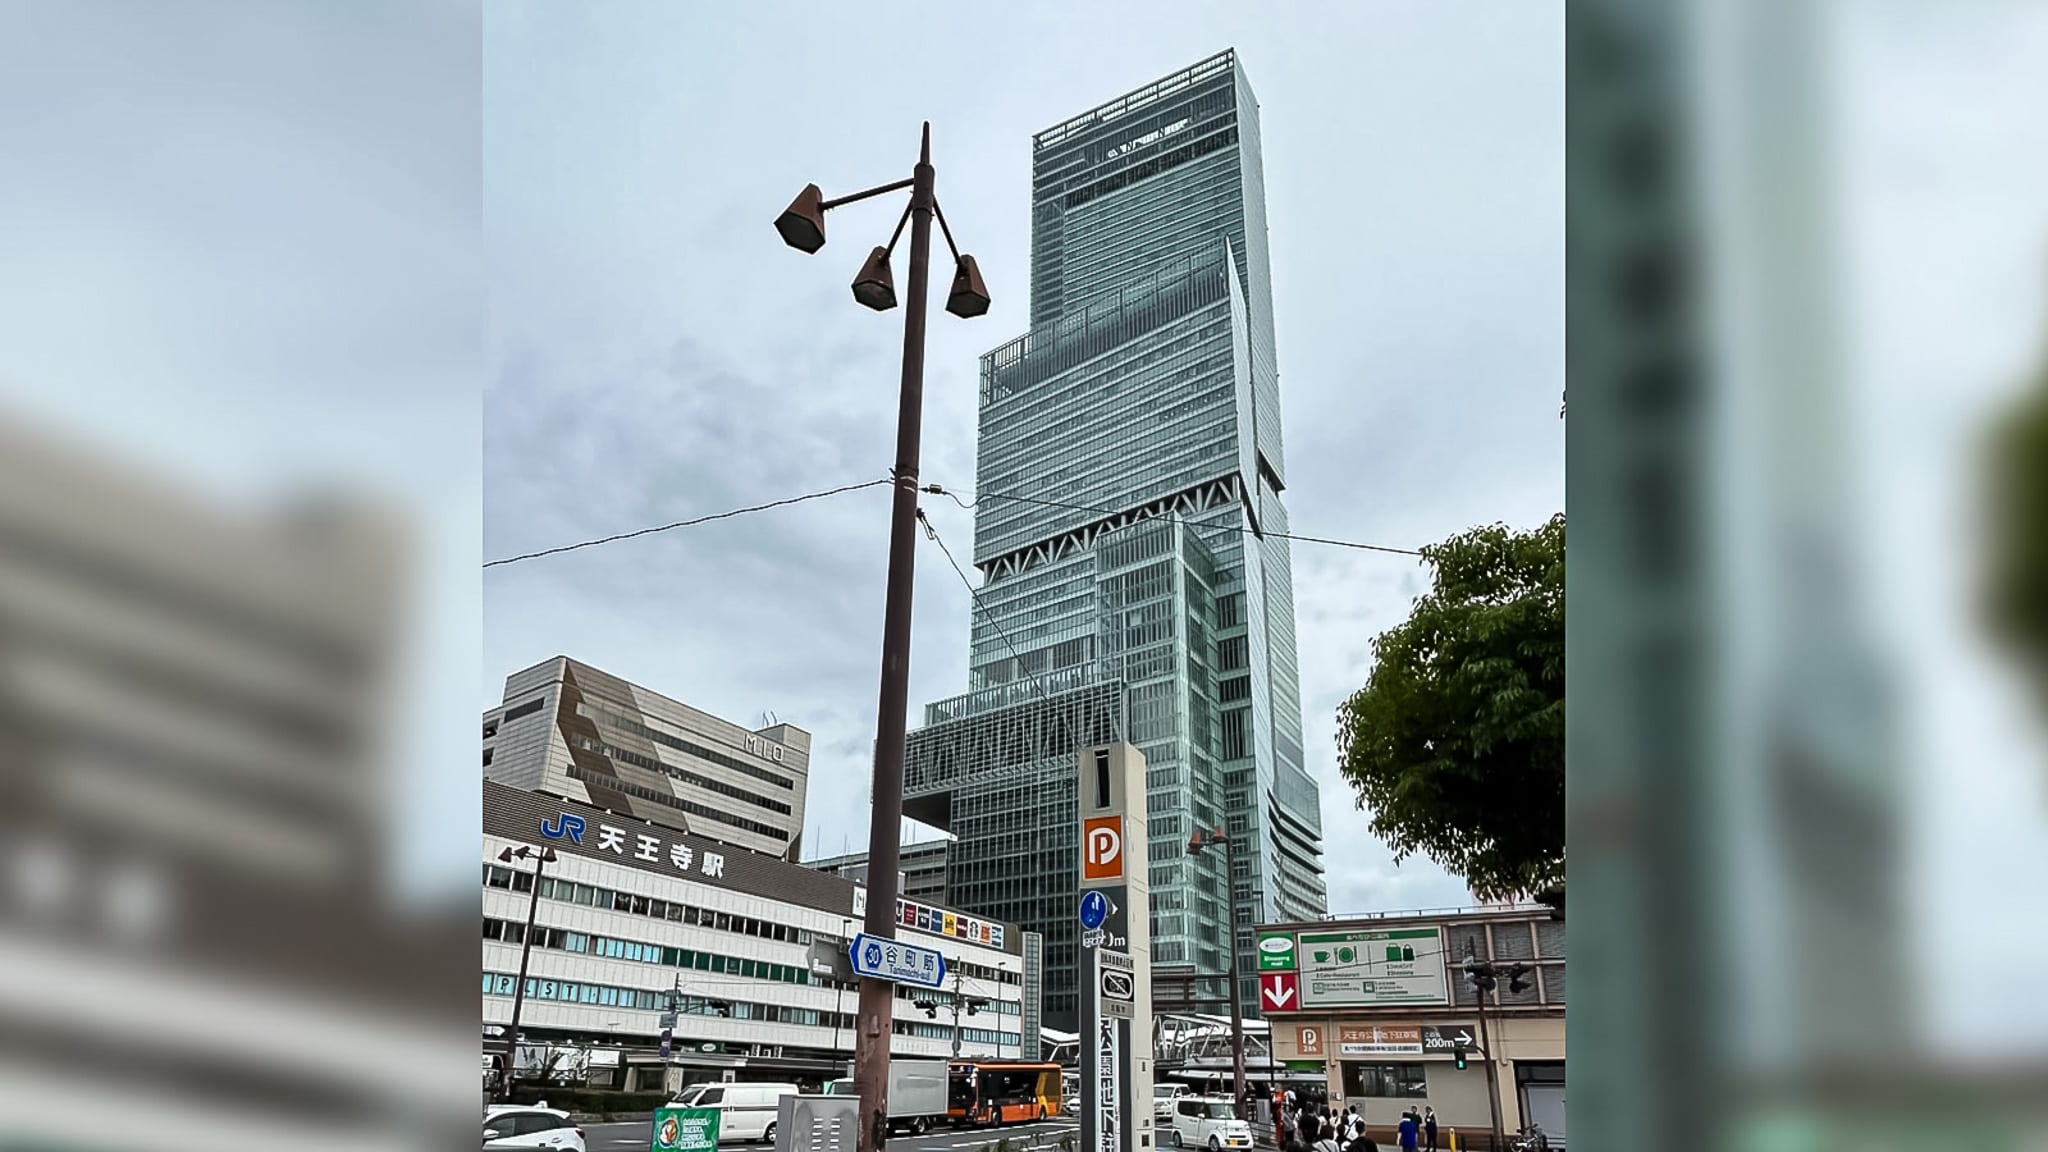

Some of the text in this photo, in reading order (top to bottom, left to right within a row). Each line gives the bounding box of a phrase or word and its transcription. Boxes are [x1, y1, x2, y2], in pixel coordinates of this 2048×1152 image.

[744, 732, 784, 762] MIO
[541, 812, 725, 880] JR 天王寺駅
[1088, 827, 1120, 865] P
[868, 948, 880, 964] 30
[886, 945, 935, 971] 谷町筋
[1302, 1029, 1317, 1045] P
[1425, 1037, 1455, 1049] 200m
